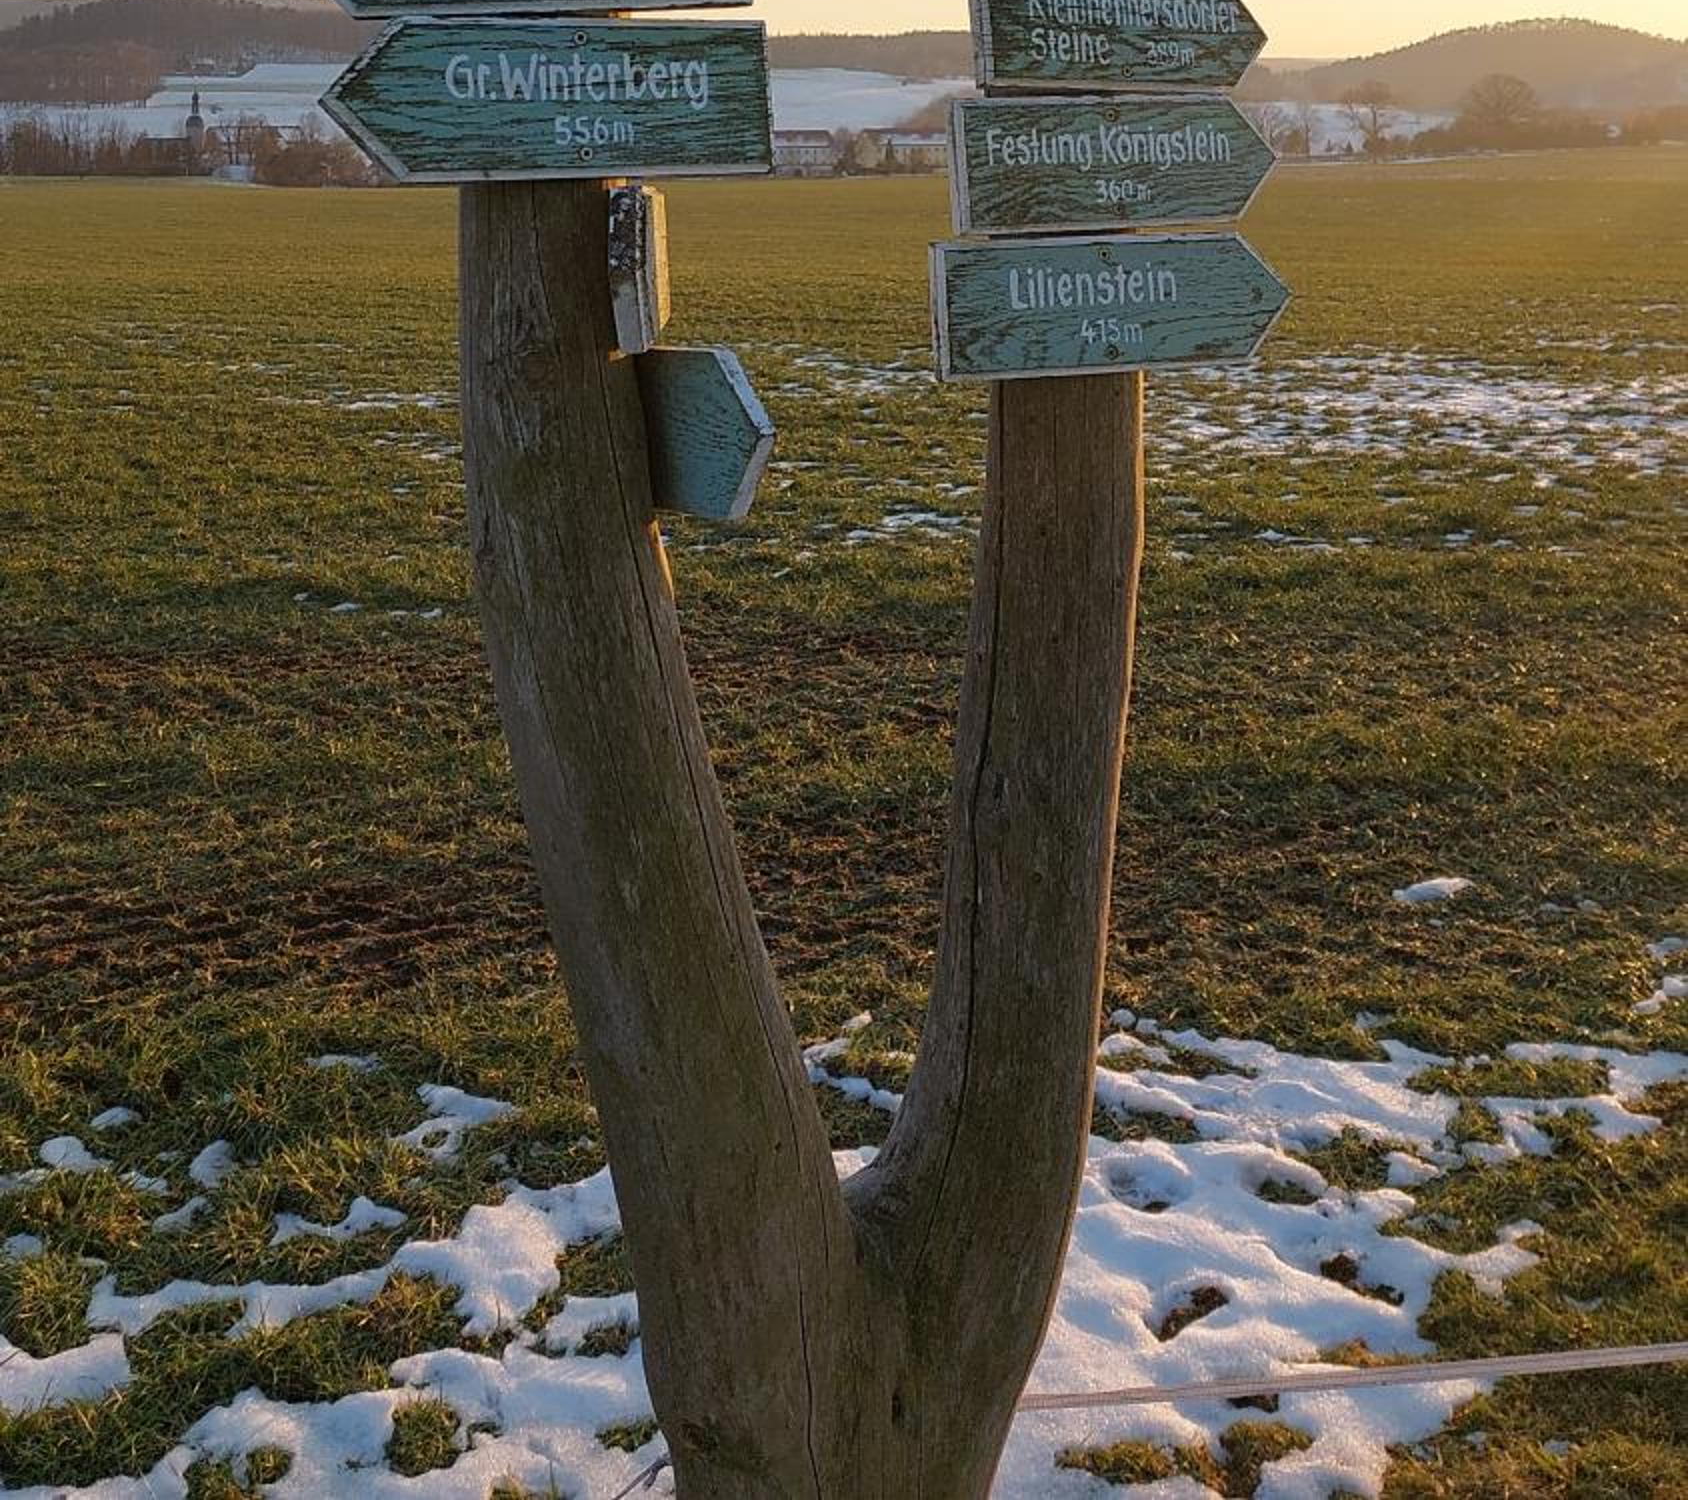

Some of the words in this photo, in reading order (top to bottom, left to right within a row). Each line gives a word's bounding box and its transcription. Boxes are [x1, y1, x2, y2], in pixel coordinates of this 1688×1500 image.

[1030, 25, 1112, 65] Steine
[986, 128, 1091, 172] Festung
[1100, 123, 1232, 172] Königstein
[1008, 261, 1178, 310] Lilienstein
